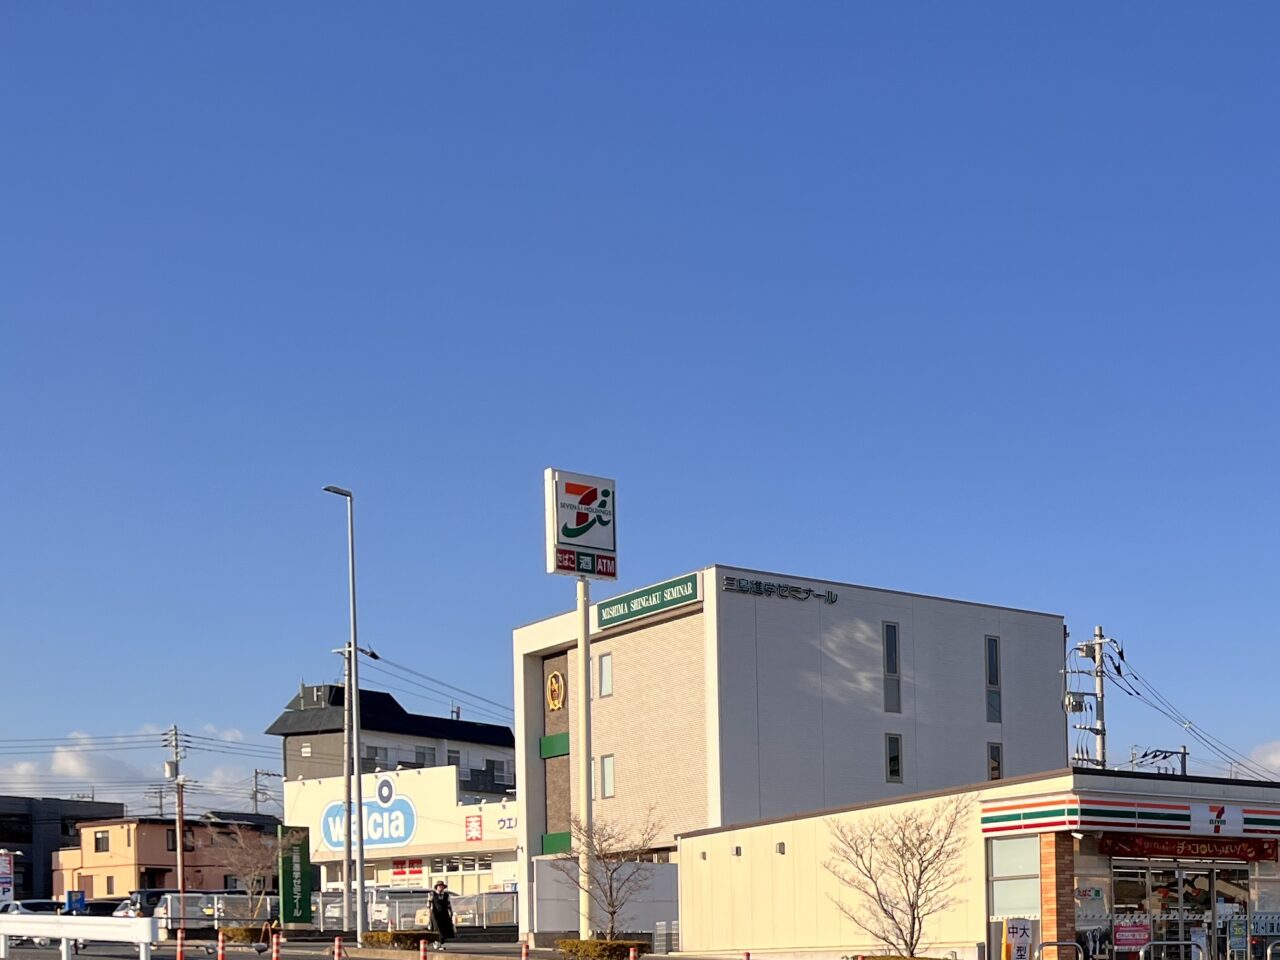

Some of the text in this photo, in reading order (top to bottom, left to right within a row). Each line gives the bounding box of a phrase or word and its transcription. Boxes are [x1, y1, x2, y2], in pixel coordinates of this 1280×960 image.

[579, 555, 592, 570] 酒
[597, 558, 615, 573] ATM
[601, 582, 693, 620] MISHIMA SHINGAKU SEMINAR
[722, 576, 838, 605] 三島進学ゼミナール
